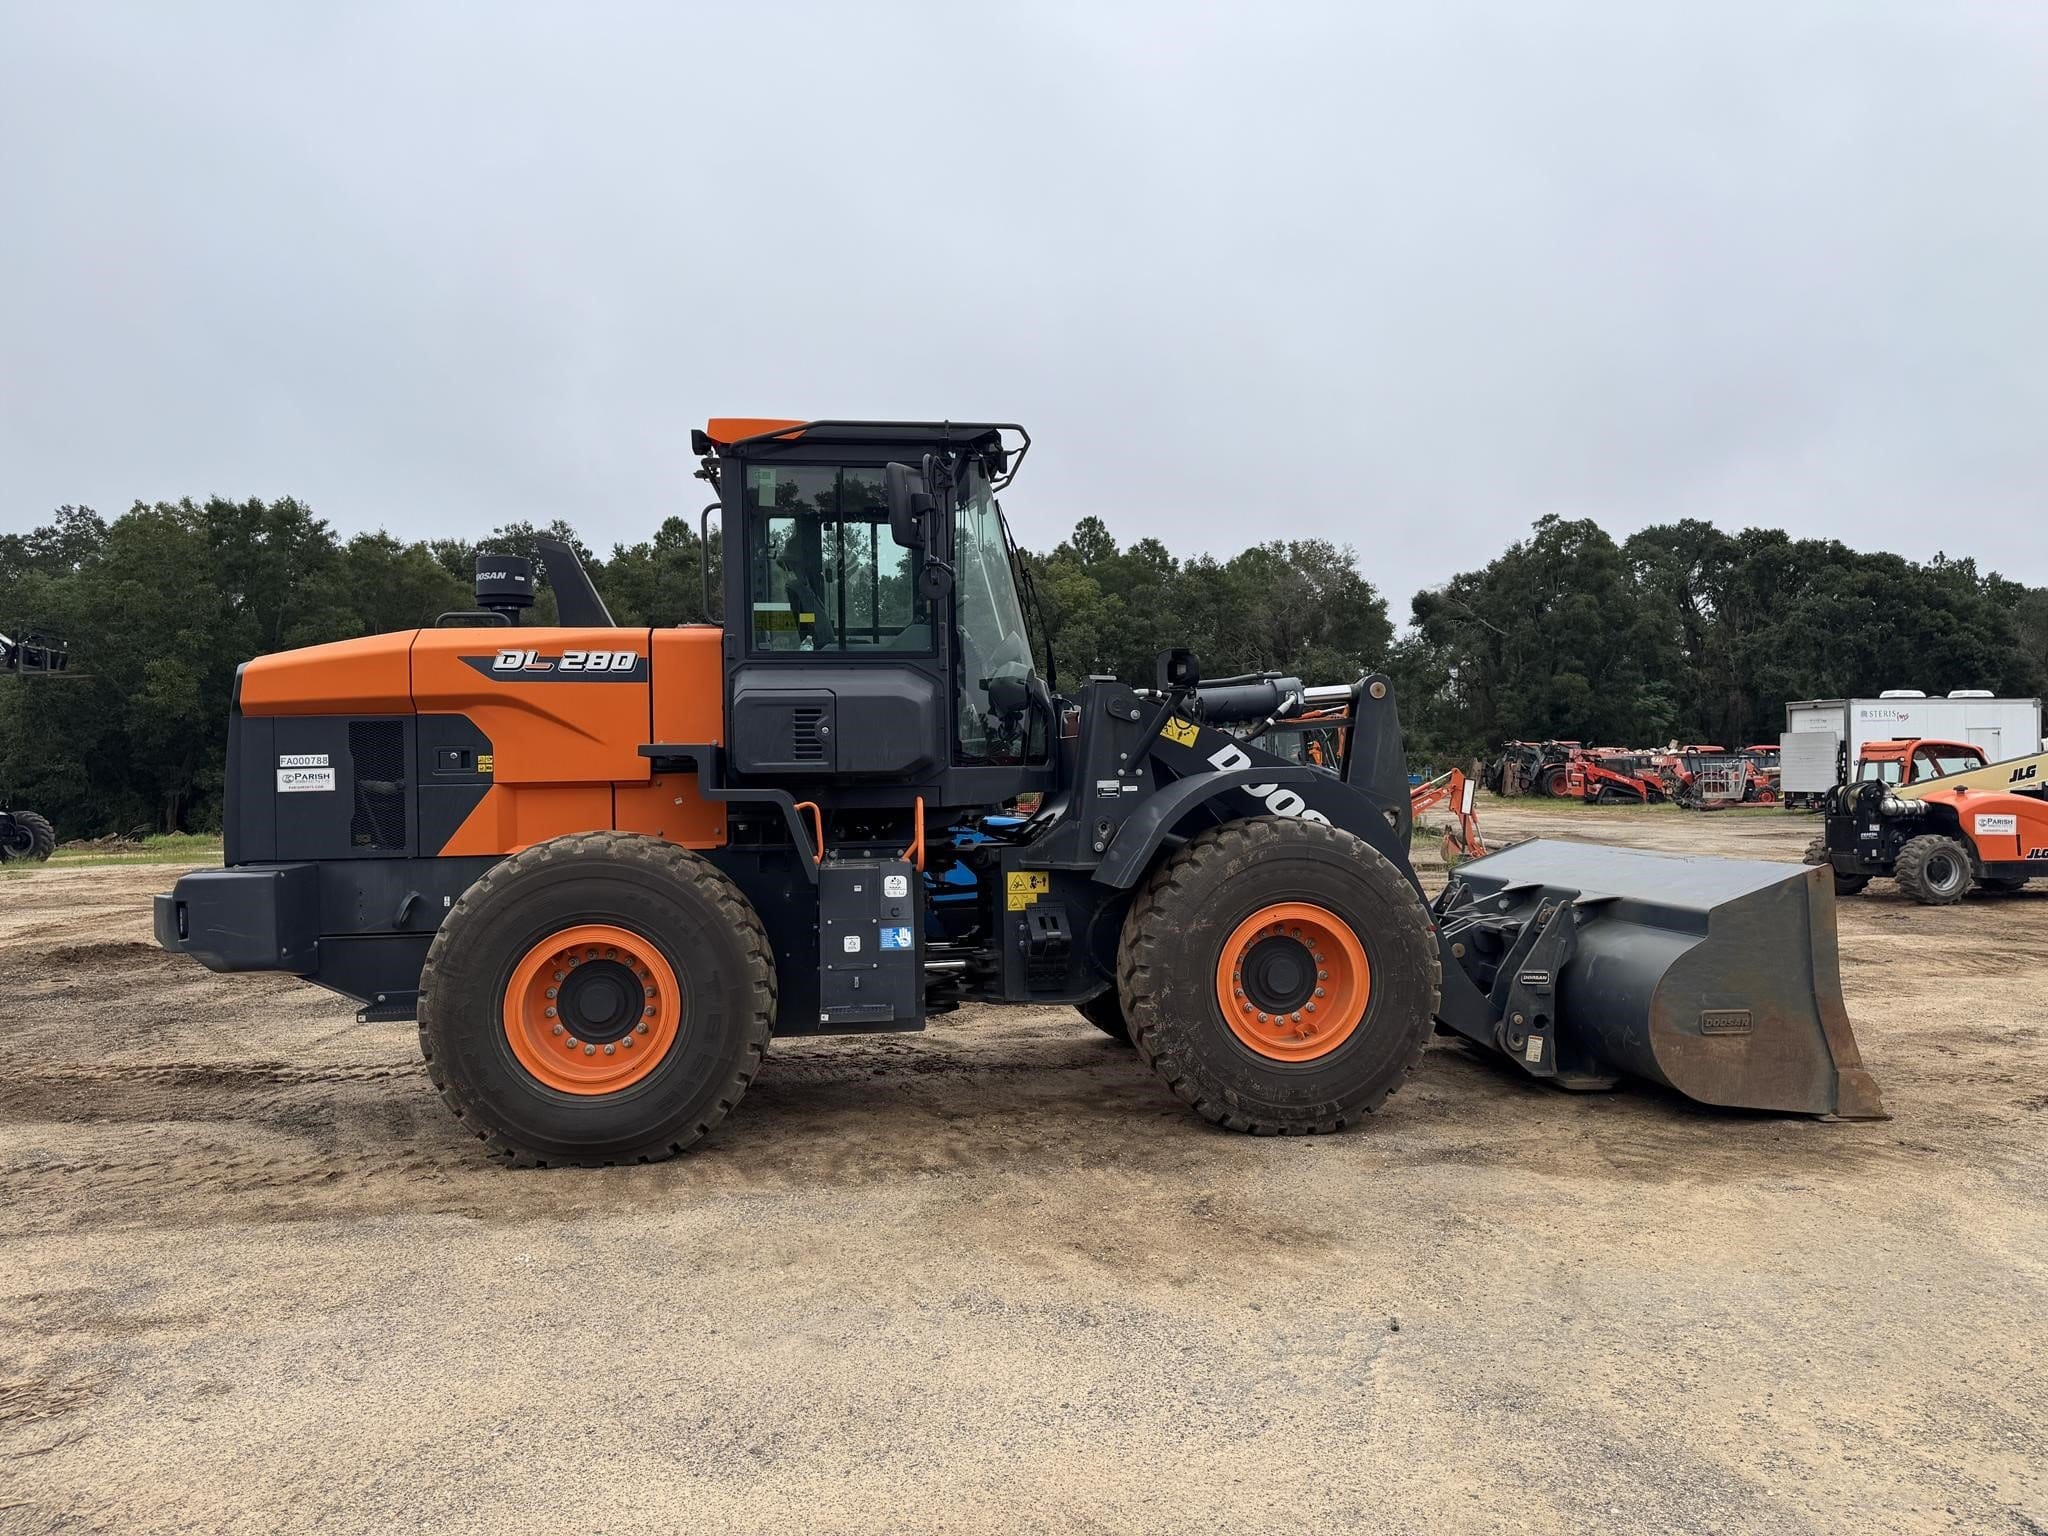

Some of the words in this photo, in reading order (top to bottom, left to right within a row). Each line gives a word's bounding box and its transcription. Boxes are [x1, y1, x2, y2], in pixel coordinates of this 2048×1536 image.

[492, 649, 554, 672] DL
[558, 650, 639, 672] 280
[1869, 710, 1896, 718] STERIS
[280, 756, 328, 765] FA000788
[294, 772, 330, 780] PARISH
[2009, 764, 2037, 783] JLG
[1987, 817, 2013, 825] PARISH
[2026, 848, 2048, 859] JLG
